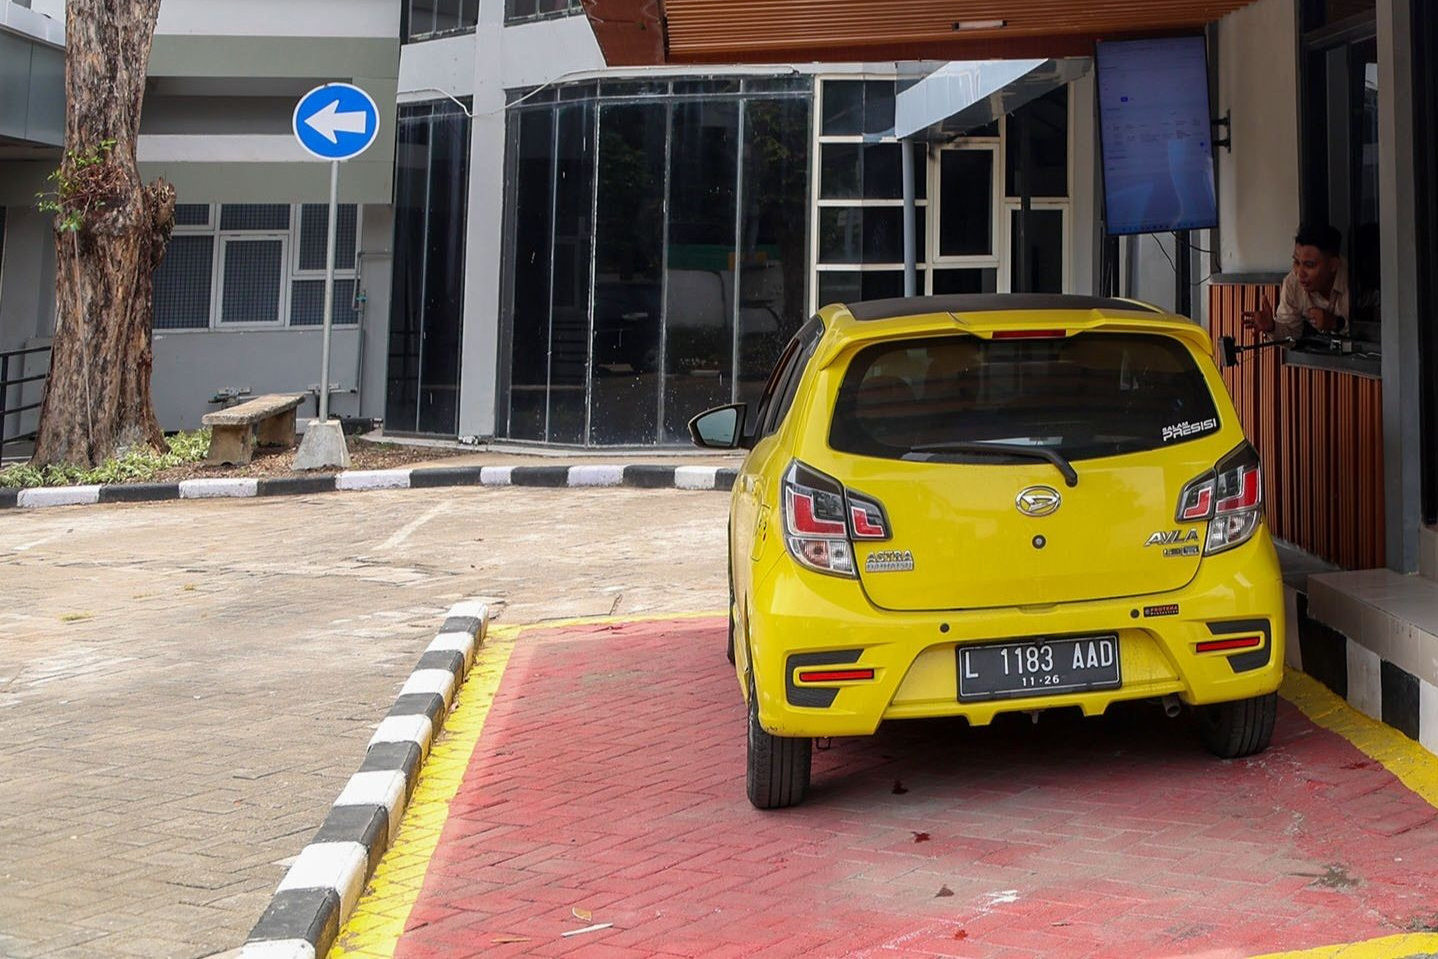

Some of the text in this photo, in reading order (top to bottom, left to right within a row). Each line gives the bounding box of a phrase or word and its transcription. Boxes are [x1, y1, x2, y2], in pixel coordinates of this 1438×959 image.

[1162, 421, 1189, 433] SALAM
[1163, 418, 1216, 441] PRESISI
[965, 640, 1113, 678] L 1183 AAD
